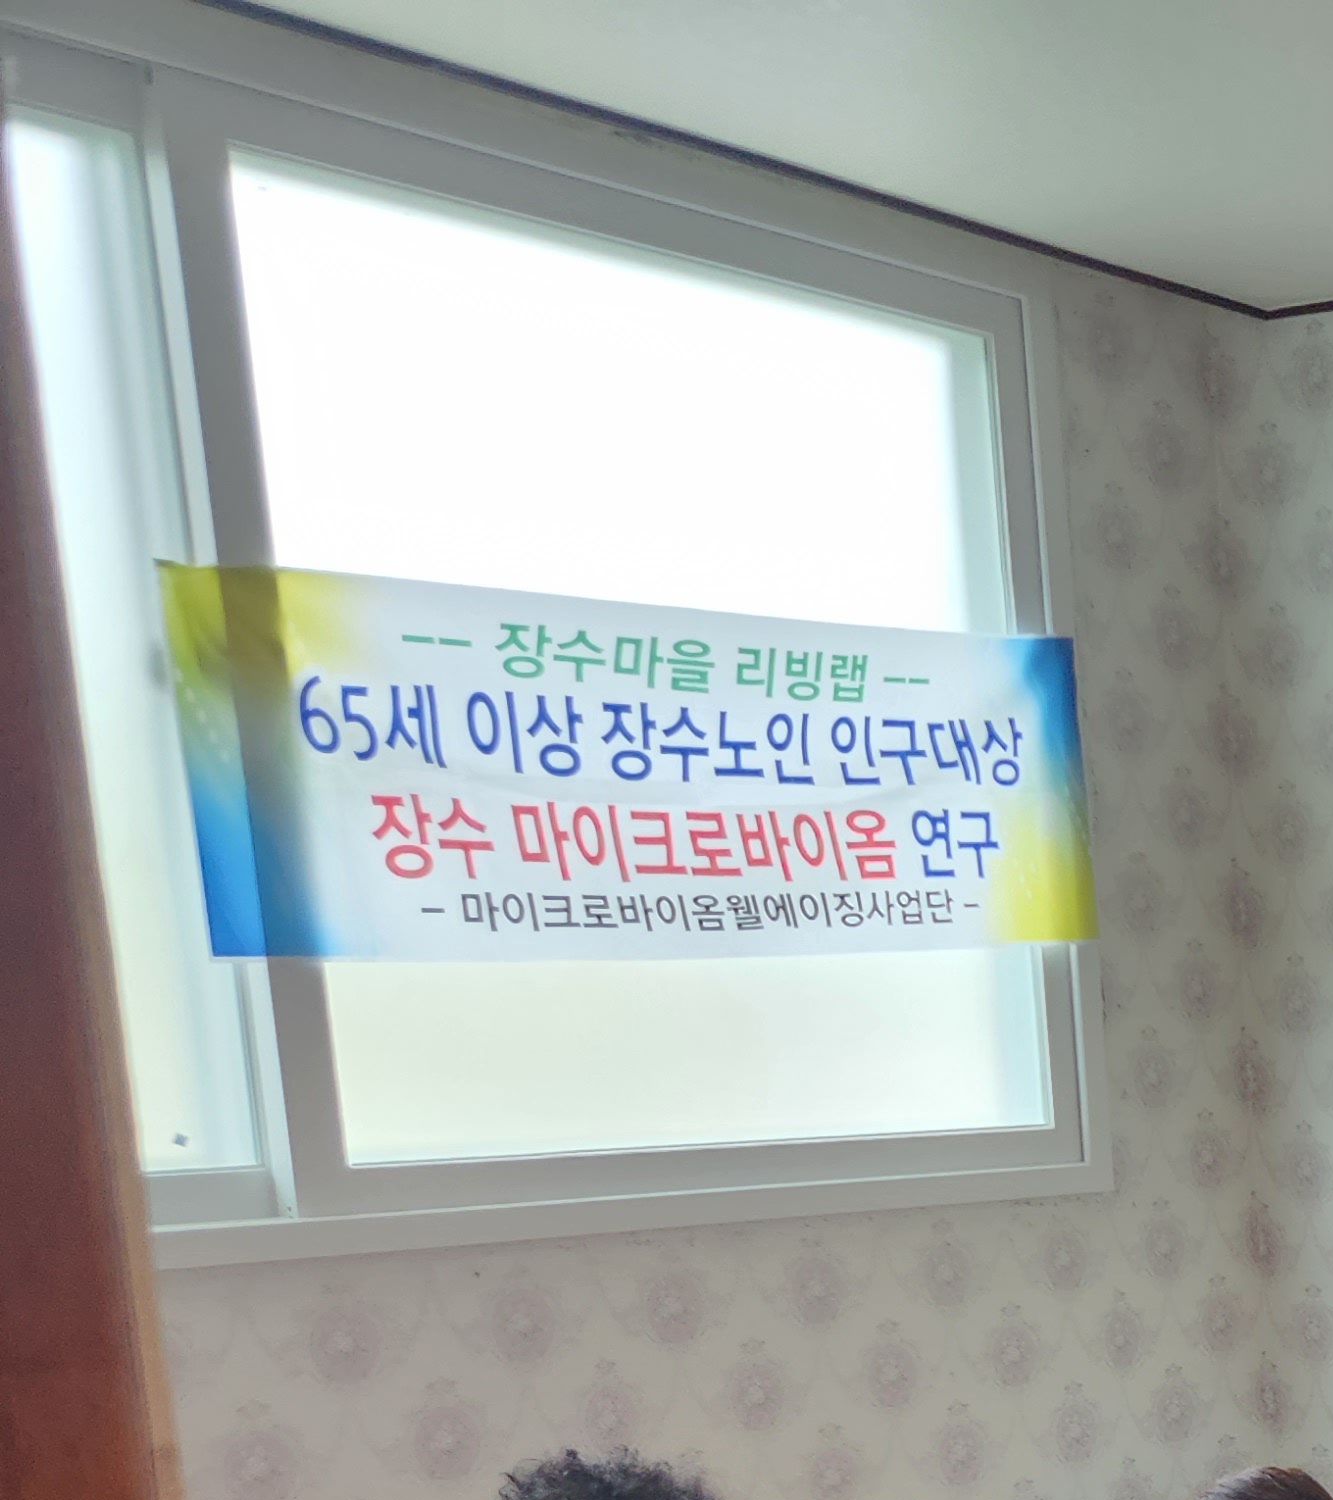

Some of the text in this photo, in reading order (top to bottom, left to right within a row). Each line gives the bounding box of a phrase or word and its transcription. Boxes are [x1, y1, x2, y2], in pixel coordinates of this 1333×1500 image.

[494, 622, 717, 694] 장수마을
[736, 646, 869, 703] 리빙랩
[298, 675, 1022, 787] 65세 이상 장수노인 인구대상
[370, 792, 1000, 882] 장수 마이크로바이옴 연구
[460, 889, 953, 932] 마이크로바이옴웰에이징사업단
